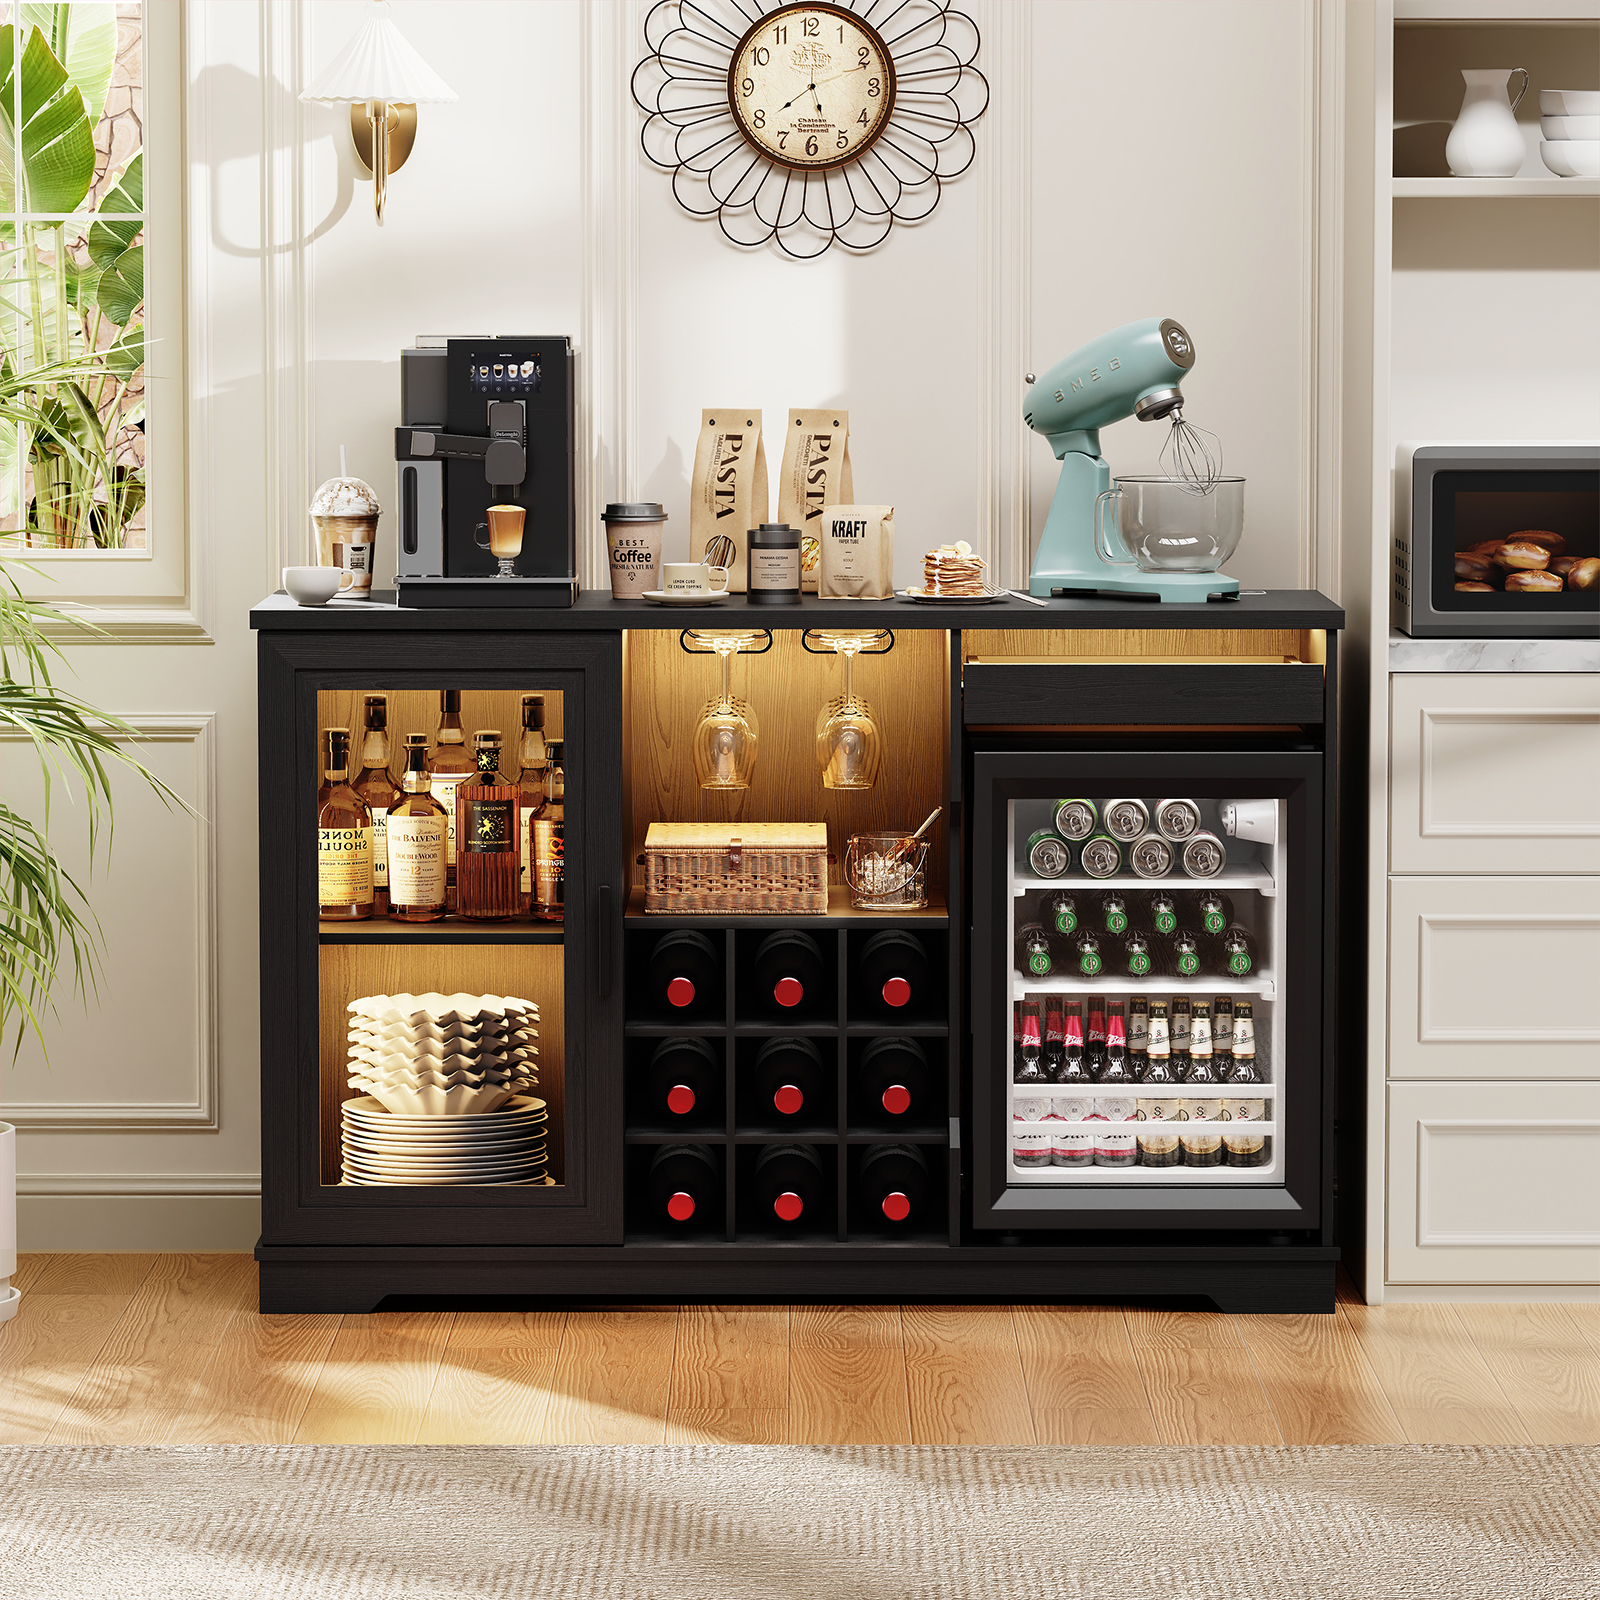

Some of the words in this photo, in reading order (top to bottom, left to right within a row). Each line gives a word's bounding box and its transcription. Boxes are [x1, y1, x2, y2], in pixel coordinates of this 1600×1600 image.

[773, 25, 787, 45] 11
[800, 17, 820, 37] 12
[836, 25, 844, 44] 1
[751, 46, 770, 66] 10
[857, 46, 871, 66] 2
[742, 77, 754, 97] 9
[867, 77, 880, 97] 3
[753, 109, 766, 129] 8
[857, 108, 870, 128] 4
[776, 130, 790, 150] 7
[805, 135, 819, 156] 6
[836, 129, 849, 148] 5
[1053, 357, 1121, 403] SMEG
[715, 433, 744, 520] PASTA
[805, 434, 832, 522] PASTA
[832, 520, 867, 538] KRAFT
[618, 539, 644, 547] BEST
[613, 549, 652, 563] Coffee
[403, 834, 442, 842] BALVENIE
[375, 863, 386, 871] 10
[411, 865, 421, 875] 12
